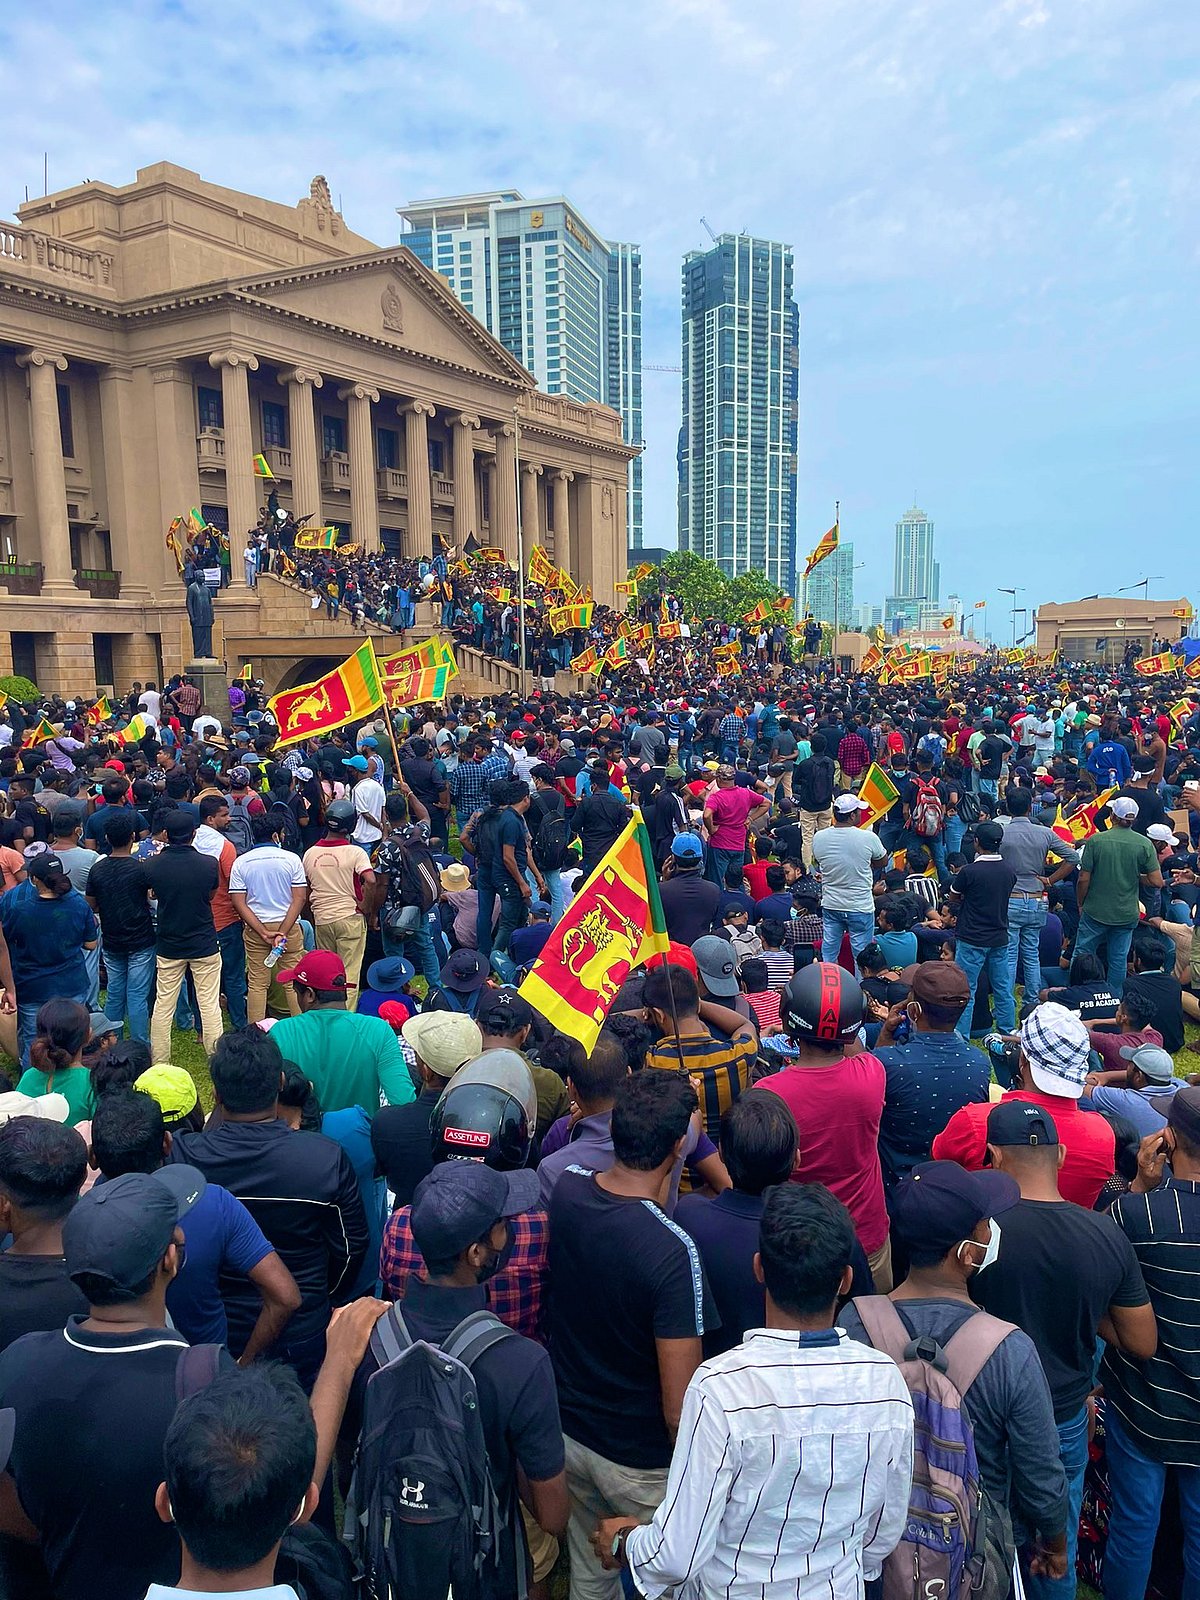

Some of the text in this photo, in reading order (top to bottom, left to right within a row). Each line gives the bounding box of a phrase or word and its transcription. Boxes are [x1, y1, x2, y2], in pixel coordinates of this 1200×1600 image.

[1093, 992, 1112, 1001] TEAM
[1079, 1001, 1095, 1009] PSB
[447, 1131, 487, 1144] ASSETLINE
[672, 1223, 690, 1241] LOOK
[694, 1273, 702, 1296] LIMIT
